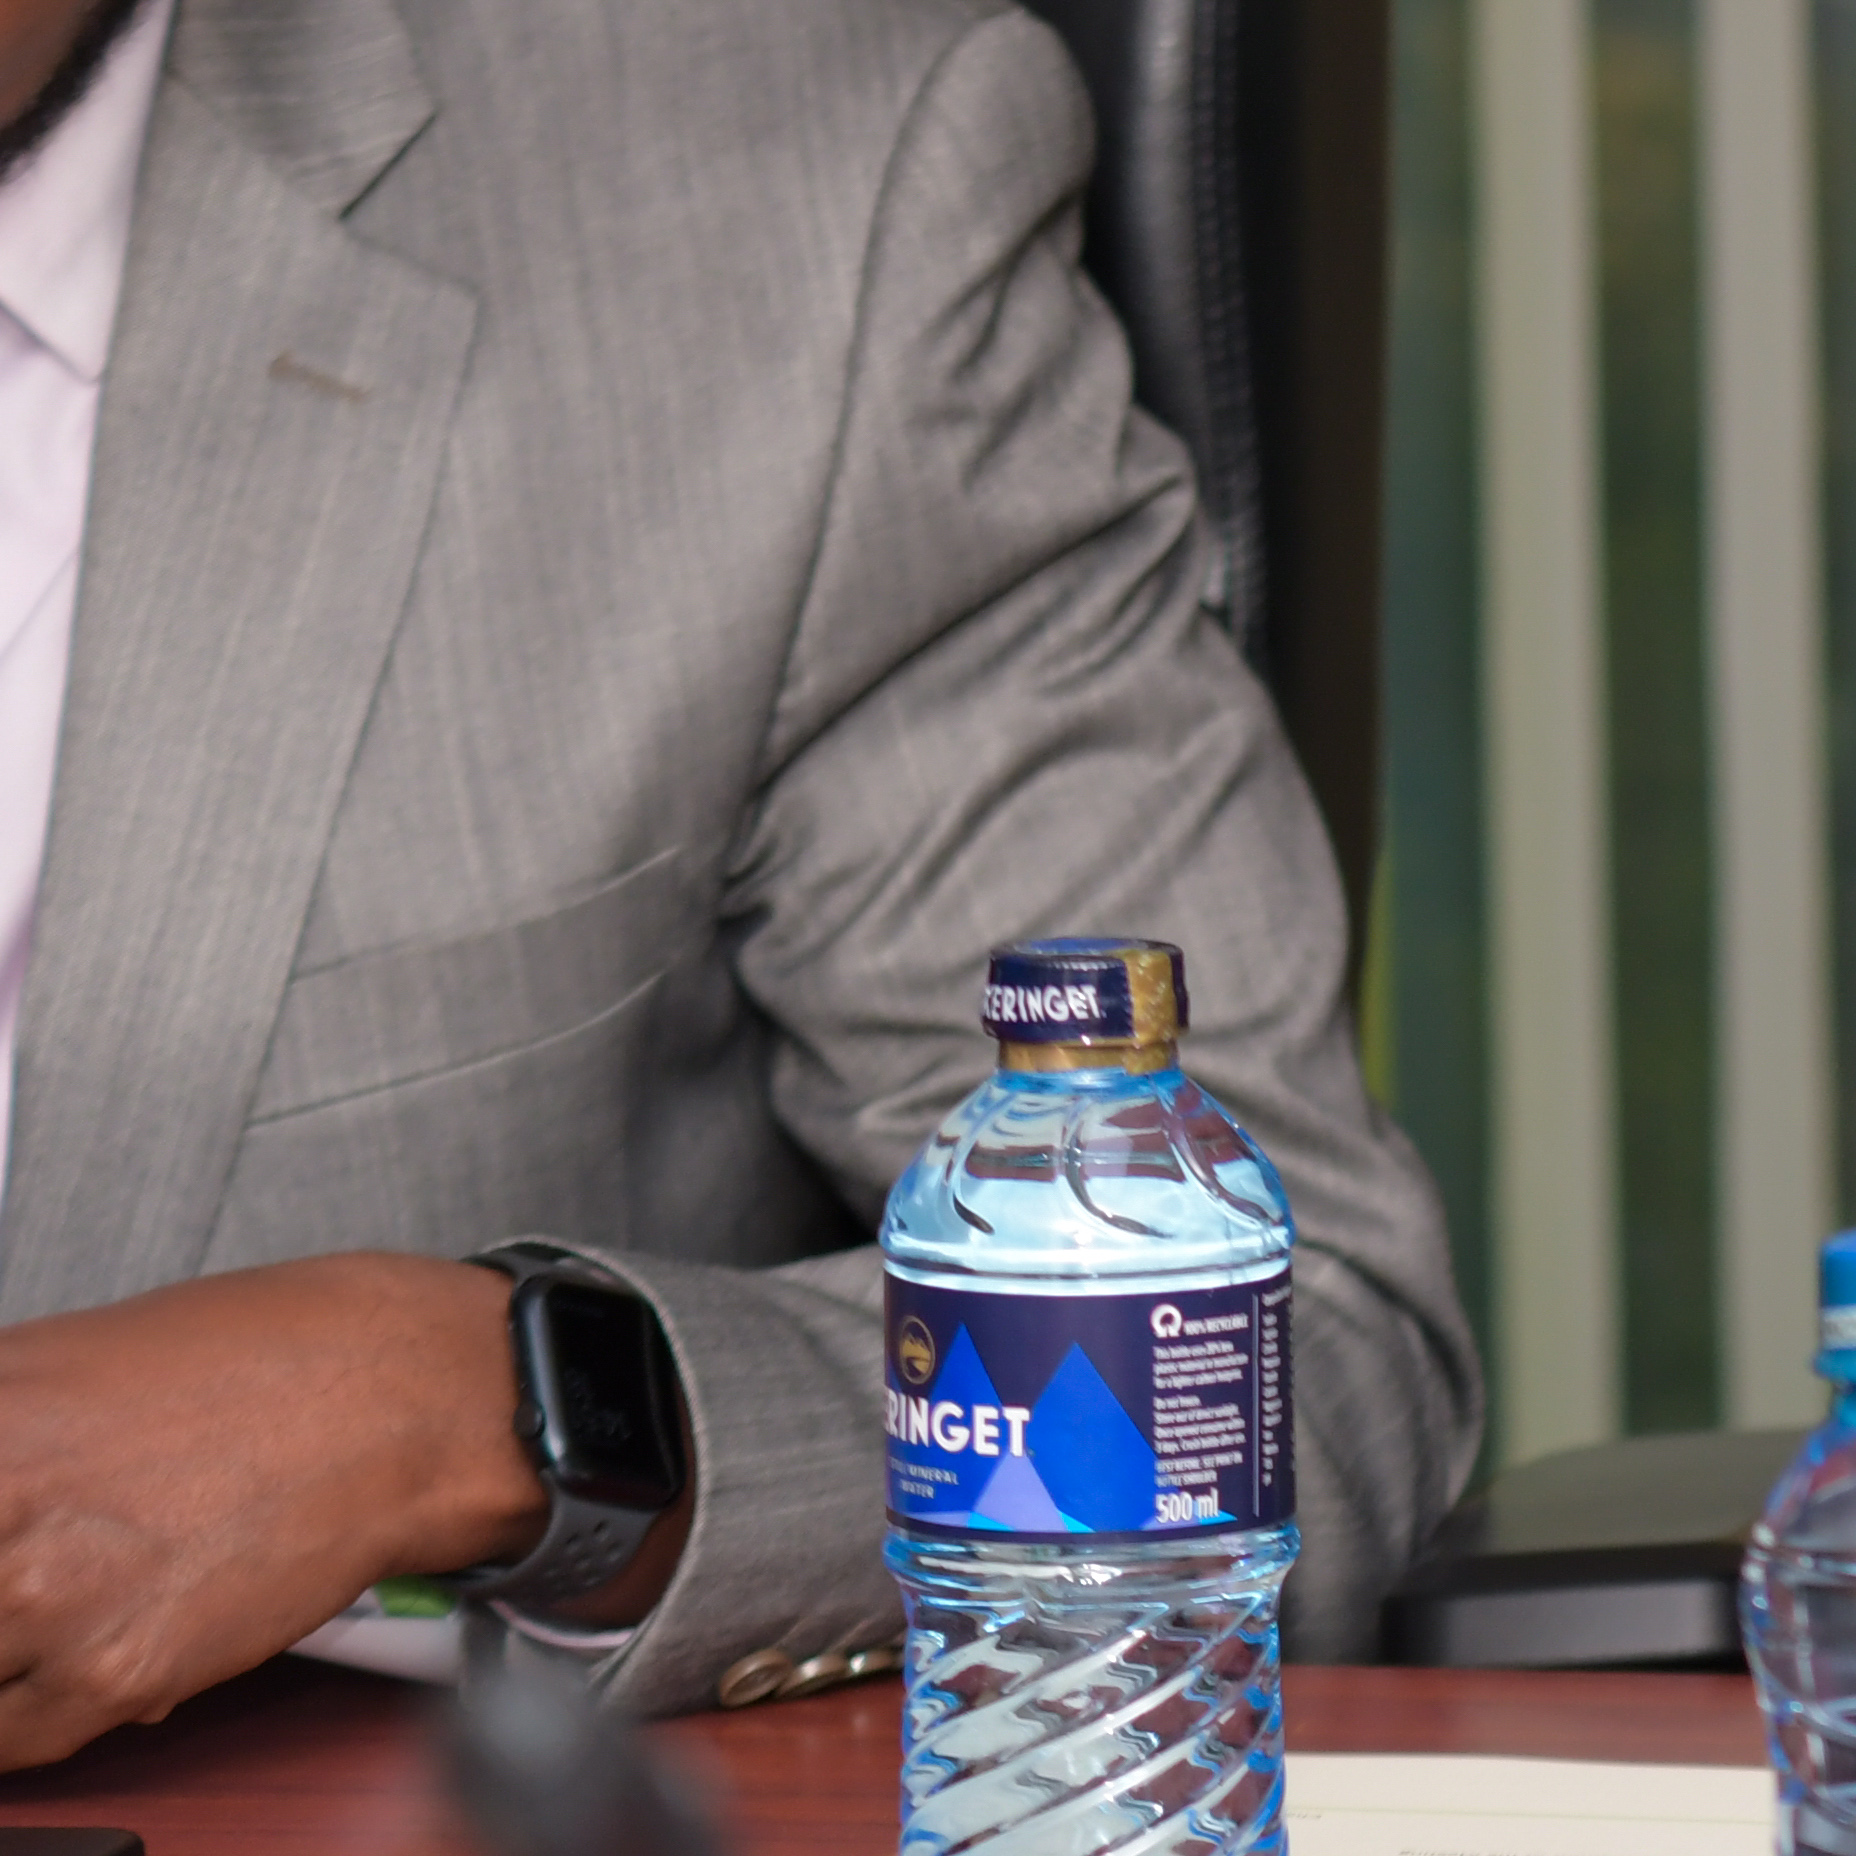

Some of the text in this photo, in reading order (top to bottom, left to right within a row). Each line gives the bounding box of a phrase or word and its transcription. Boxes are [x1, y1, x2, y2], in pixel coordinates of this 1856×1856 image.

[1204, 1313, 1249, 1334] RECYCLABLE
[884, 1387, 1030, 1458] RINGET
[907, 1464, 959, 1486] MINERAL
[900, 1478, 934, 1499] WATER
[1155, 1487, 1219, 1524] 500 ml
